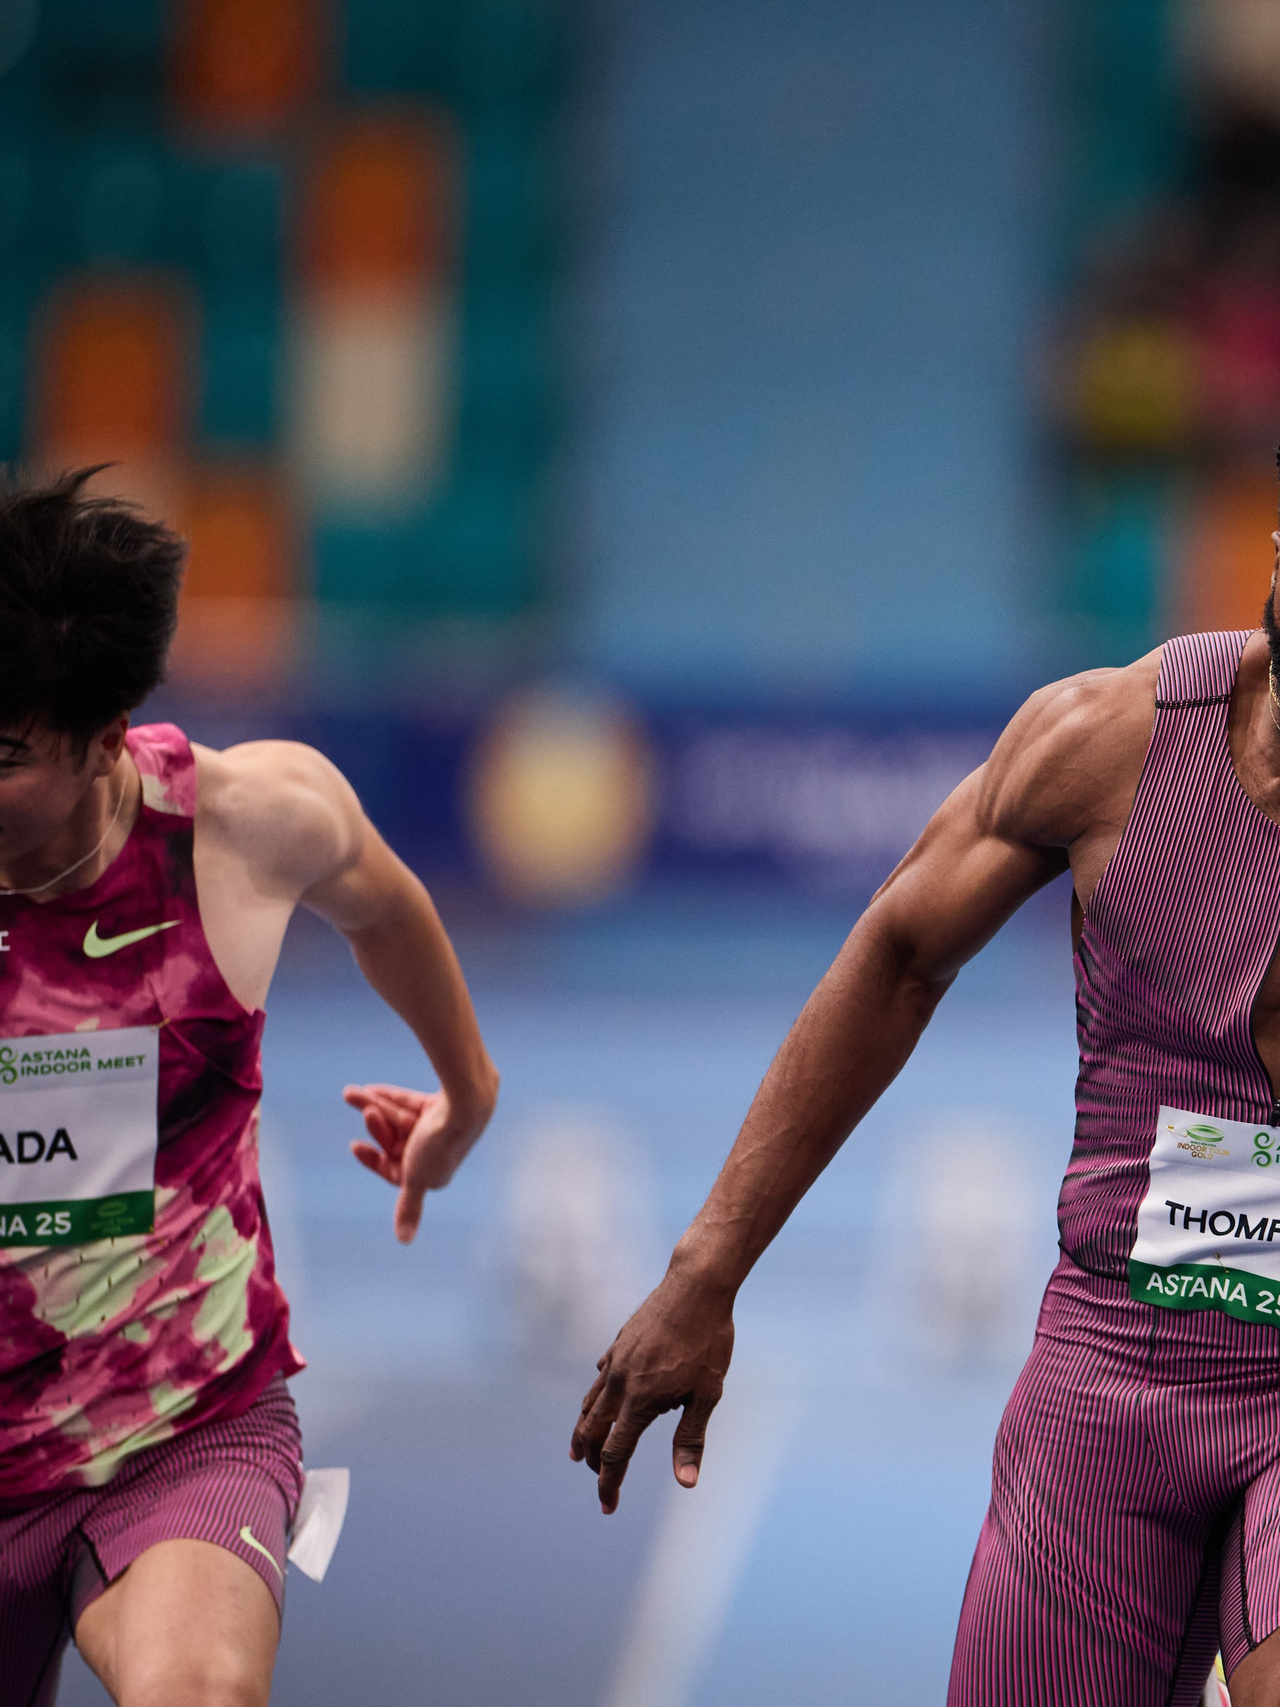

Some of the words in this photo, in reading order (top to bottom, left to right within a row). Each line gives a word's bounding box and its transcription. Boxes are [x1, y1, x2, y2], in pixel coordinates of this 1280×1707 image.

[21, 1048, 91, 1063] ASTANA
[21, 1060, 91, 1076] INDOOR
[97, 1054, 146, 1070] MEET
[35, 1211, 71, 1235] 25
[1146, 1271, 1247, 1308] ASTANA
